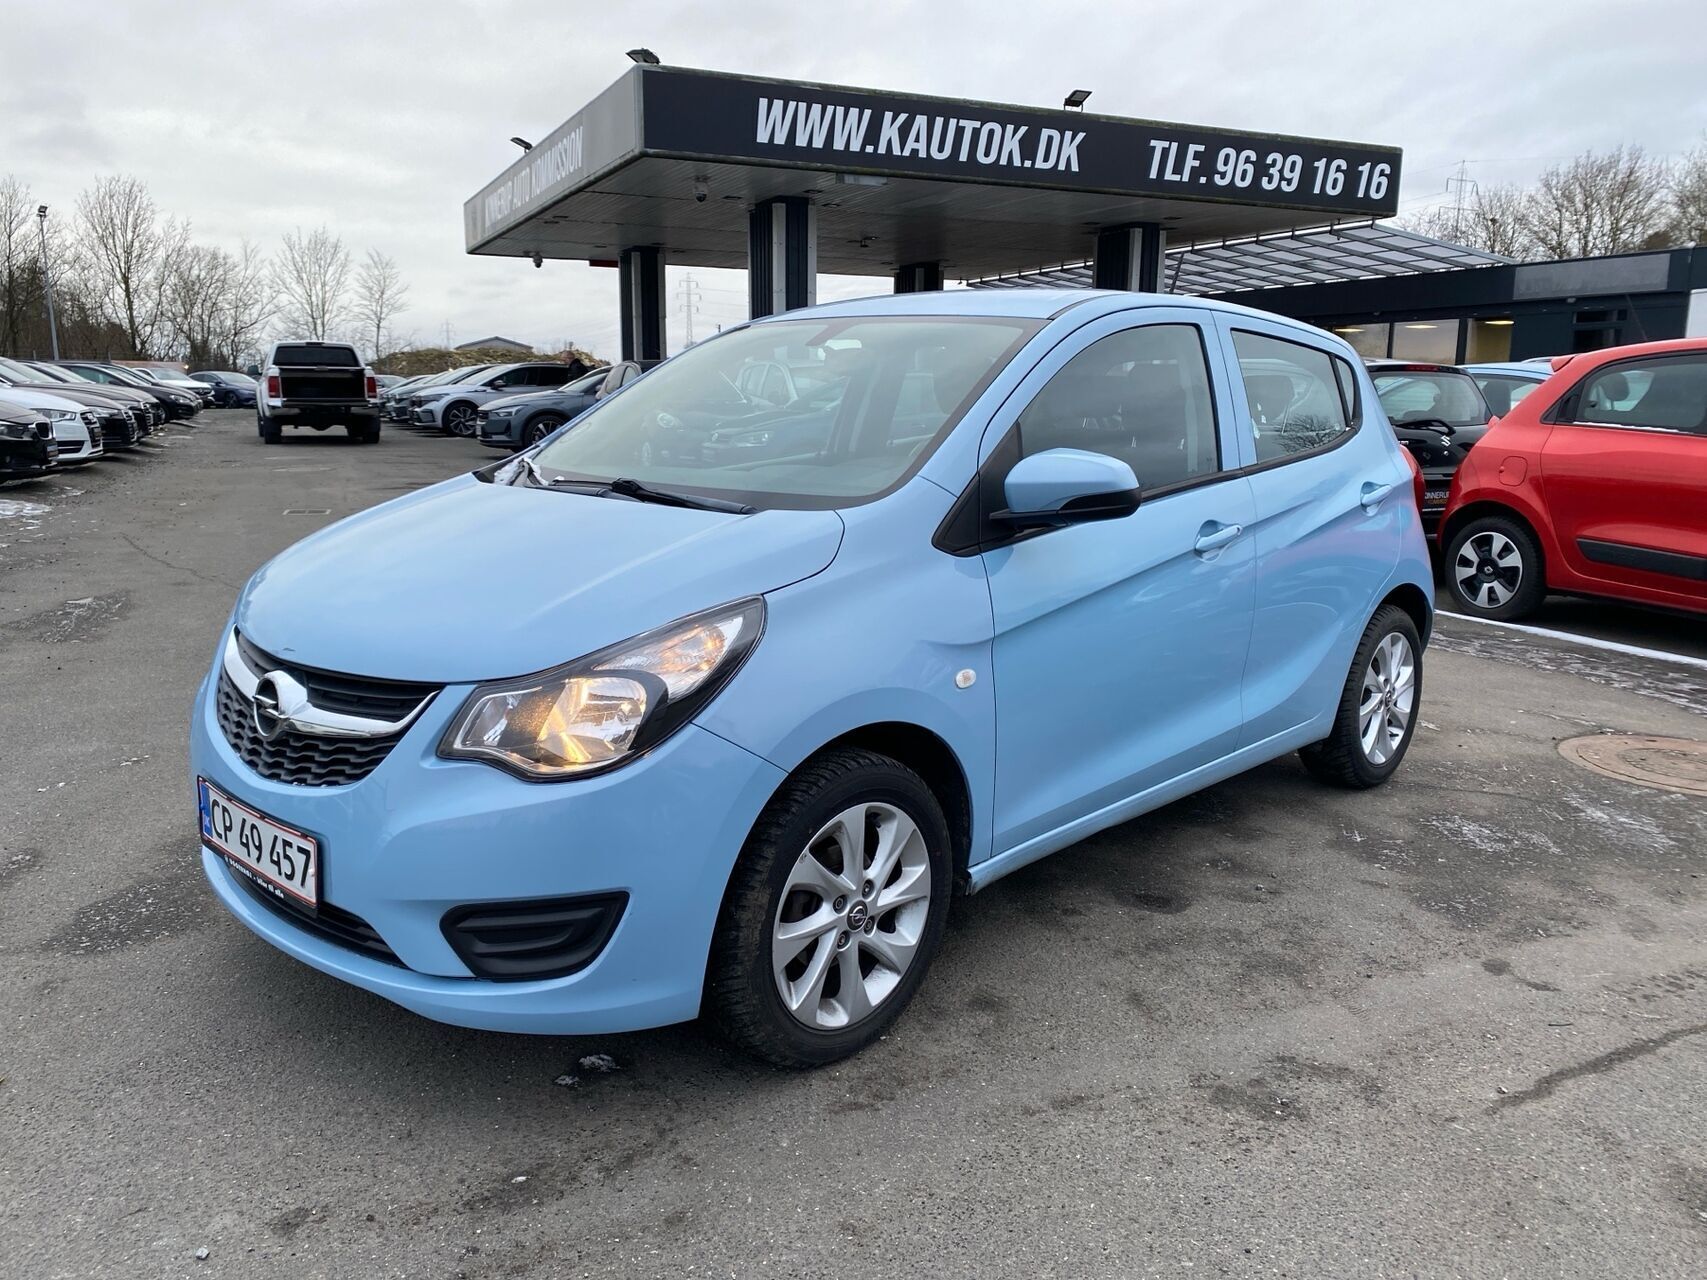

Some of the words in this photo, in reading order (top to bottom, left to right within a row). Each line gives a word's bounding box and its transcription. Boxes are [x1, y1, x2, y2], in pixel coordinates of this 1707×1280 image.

[756, 97, 1086, 172] WWW.KAUTOK.DK
[1149, 139, 1207, 184] TLF.
[1214, 147, 1257, 188] 96
[1261, 152, 1303, 193] 39
[1313, 157, 1348, 197] 16
[1357, 162, 1392, 200] 16
[211, 798, 233, 844] CP
[239, 817, 263, 864] 49
[269, 834, 312, 888] 457
